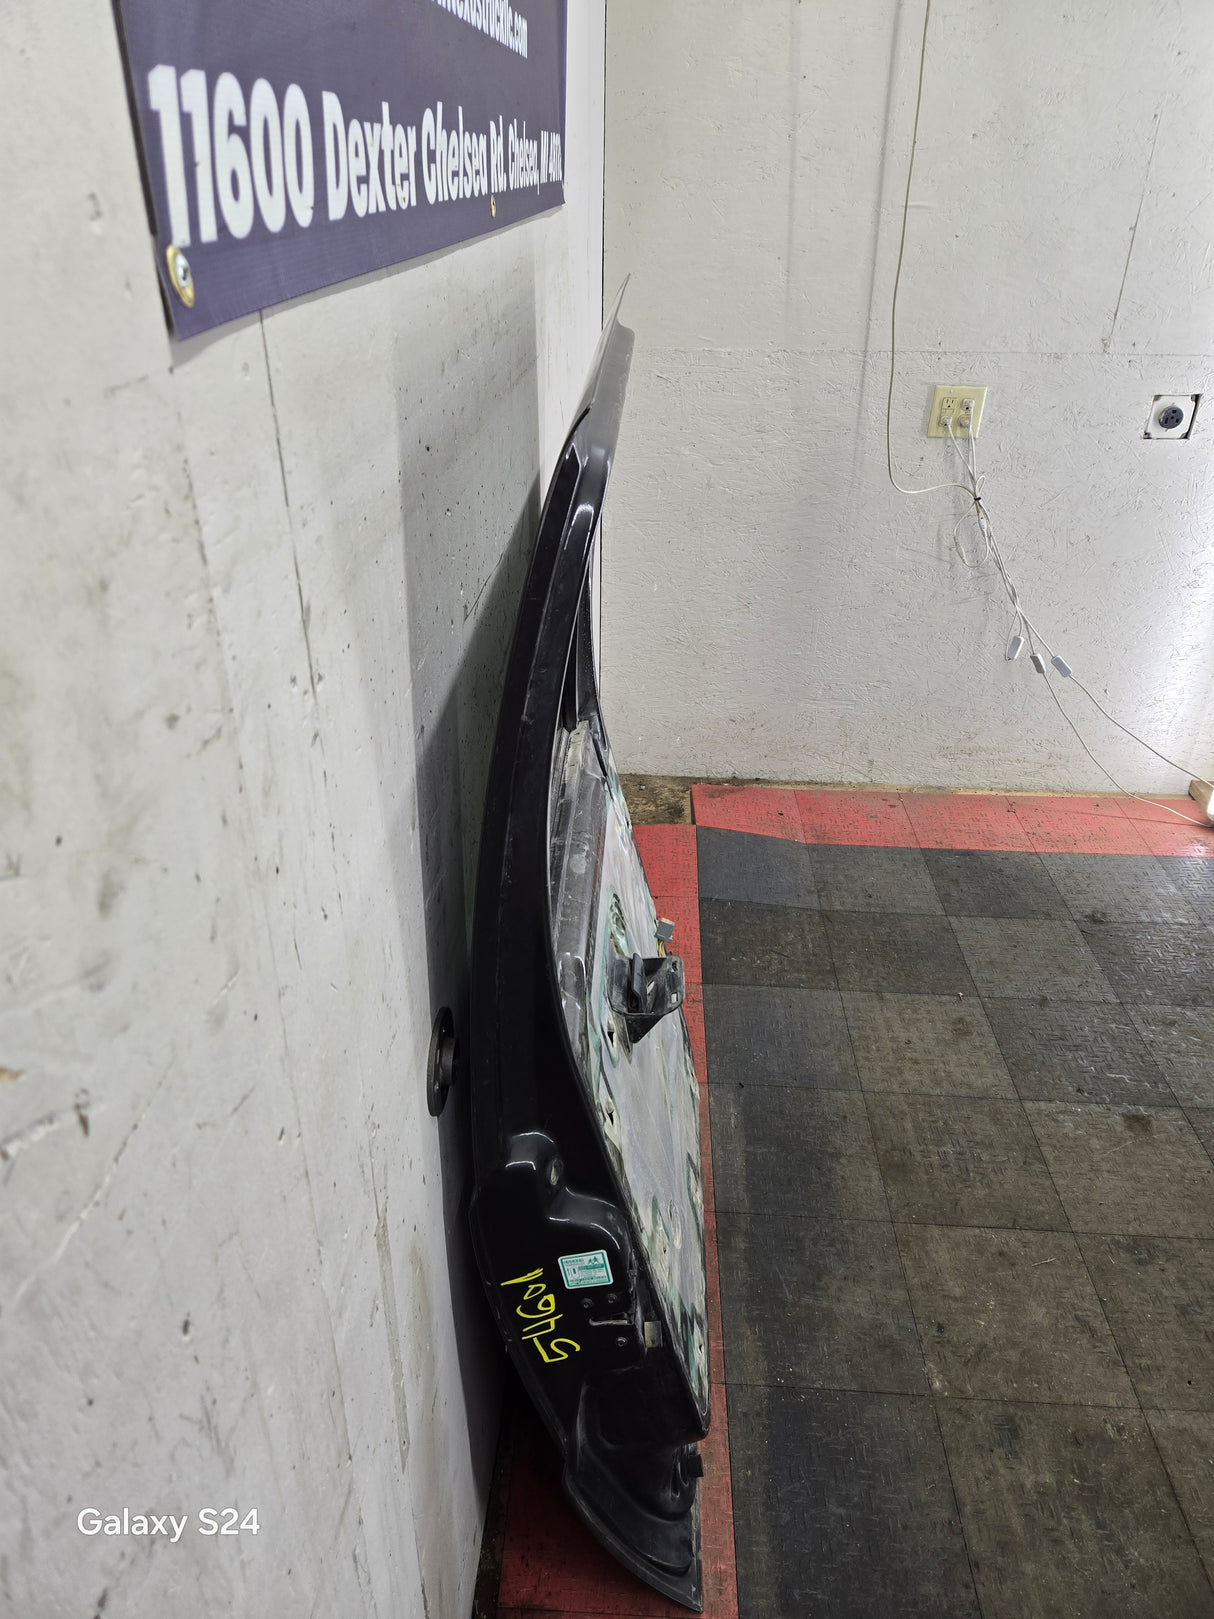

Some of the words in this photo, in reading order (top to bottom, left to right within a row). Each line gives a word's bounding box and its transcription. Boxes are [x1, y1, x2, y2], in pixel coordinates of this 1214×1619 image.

[147, 63, 315, 248] 11600
[321, 90, 417, 222] Dexter
[421, 101, 488, 205] Chelsea
[489, 114, 507, 194] Rd.
[508, 118, 540, 196] Chelsea,
[500, 1267, 581, 1363] 54601
